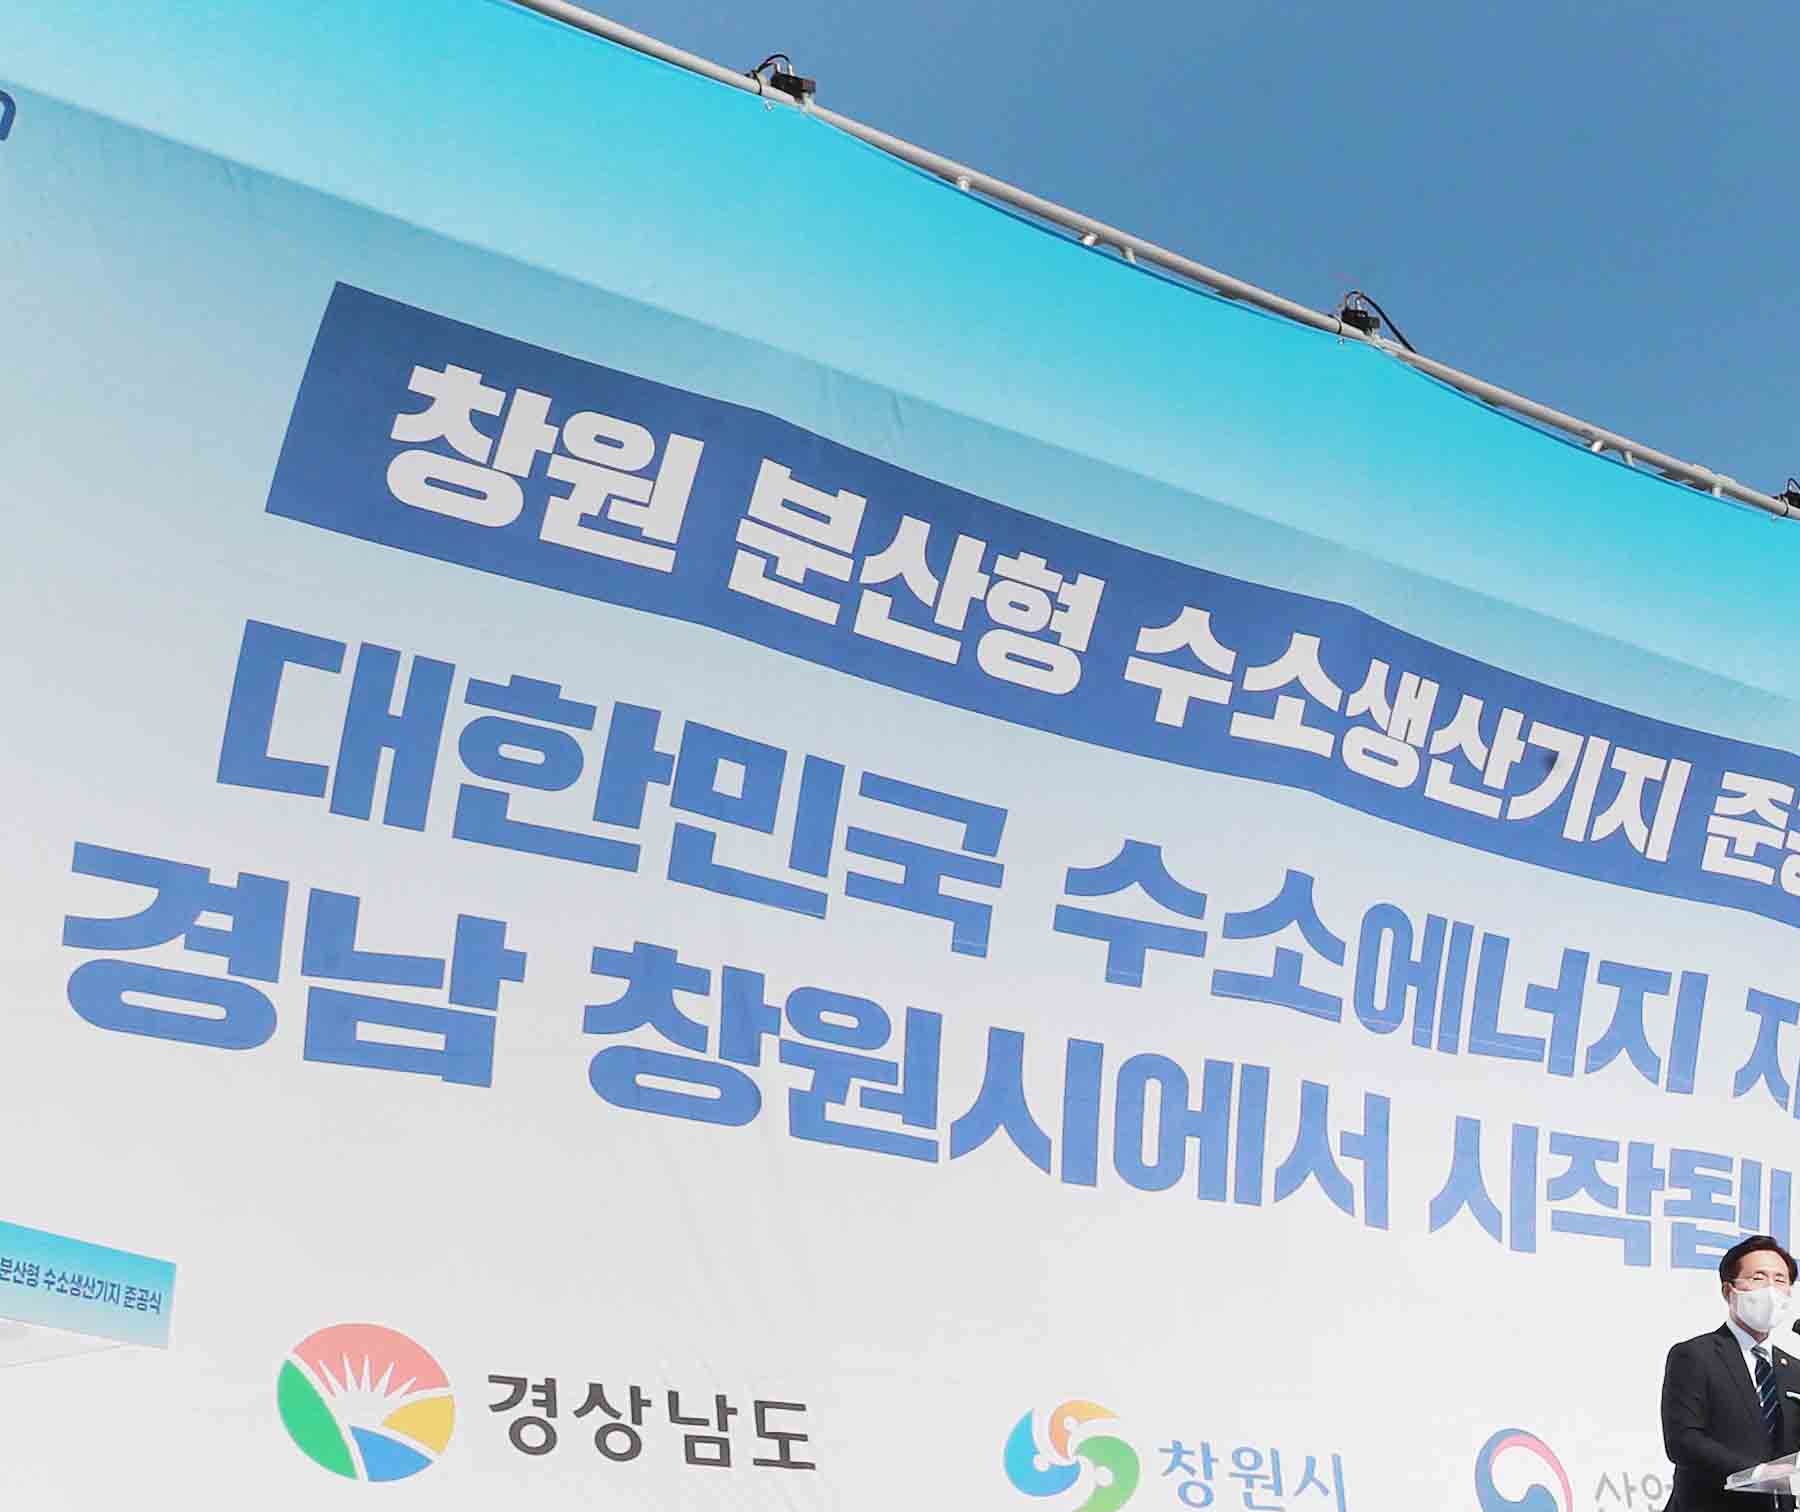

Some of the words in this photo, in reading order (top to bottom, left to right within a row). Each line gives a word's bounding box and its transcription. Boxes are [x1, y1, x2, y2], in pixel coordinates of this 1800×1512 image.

[386, 363, 705, 573] 창원
[728, 458, 1106, 696] 분산형
[1124, 605, 1692, 863] 수소생산기지
[62, 841, 526, 1088] 경남
[582, 941, 1391, 1231] 창원시에서
[216, 618, 1008, 958] 대한민국
[1052, 838, 1711, 1093] 수소에너지
[44, 1268, 120, 1304] 수소생산기지
[124, 1285, 162, 1315] 준공식
[488, 1373, 817, 1471] 경상남도
